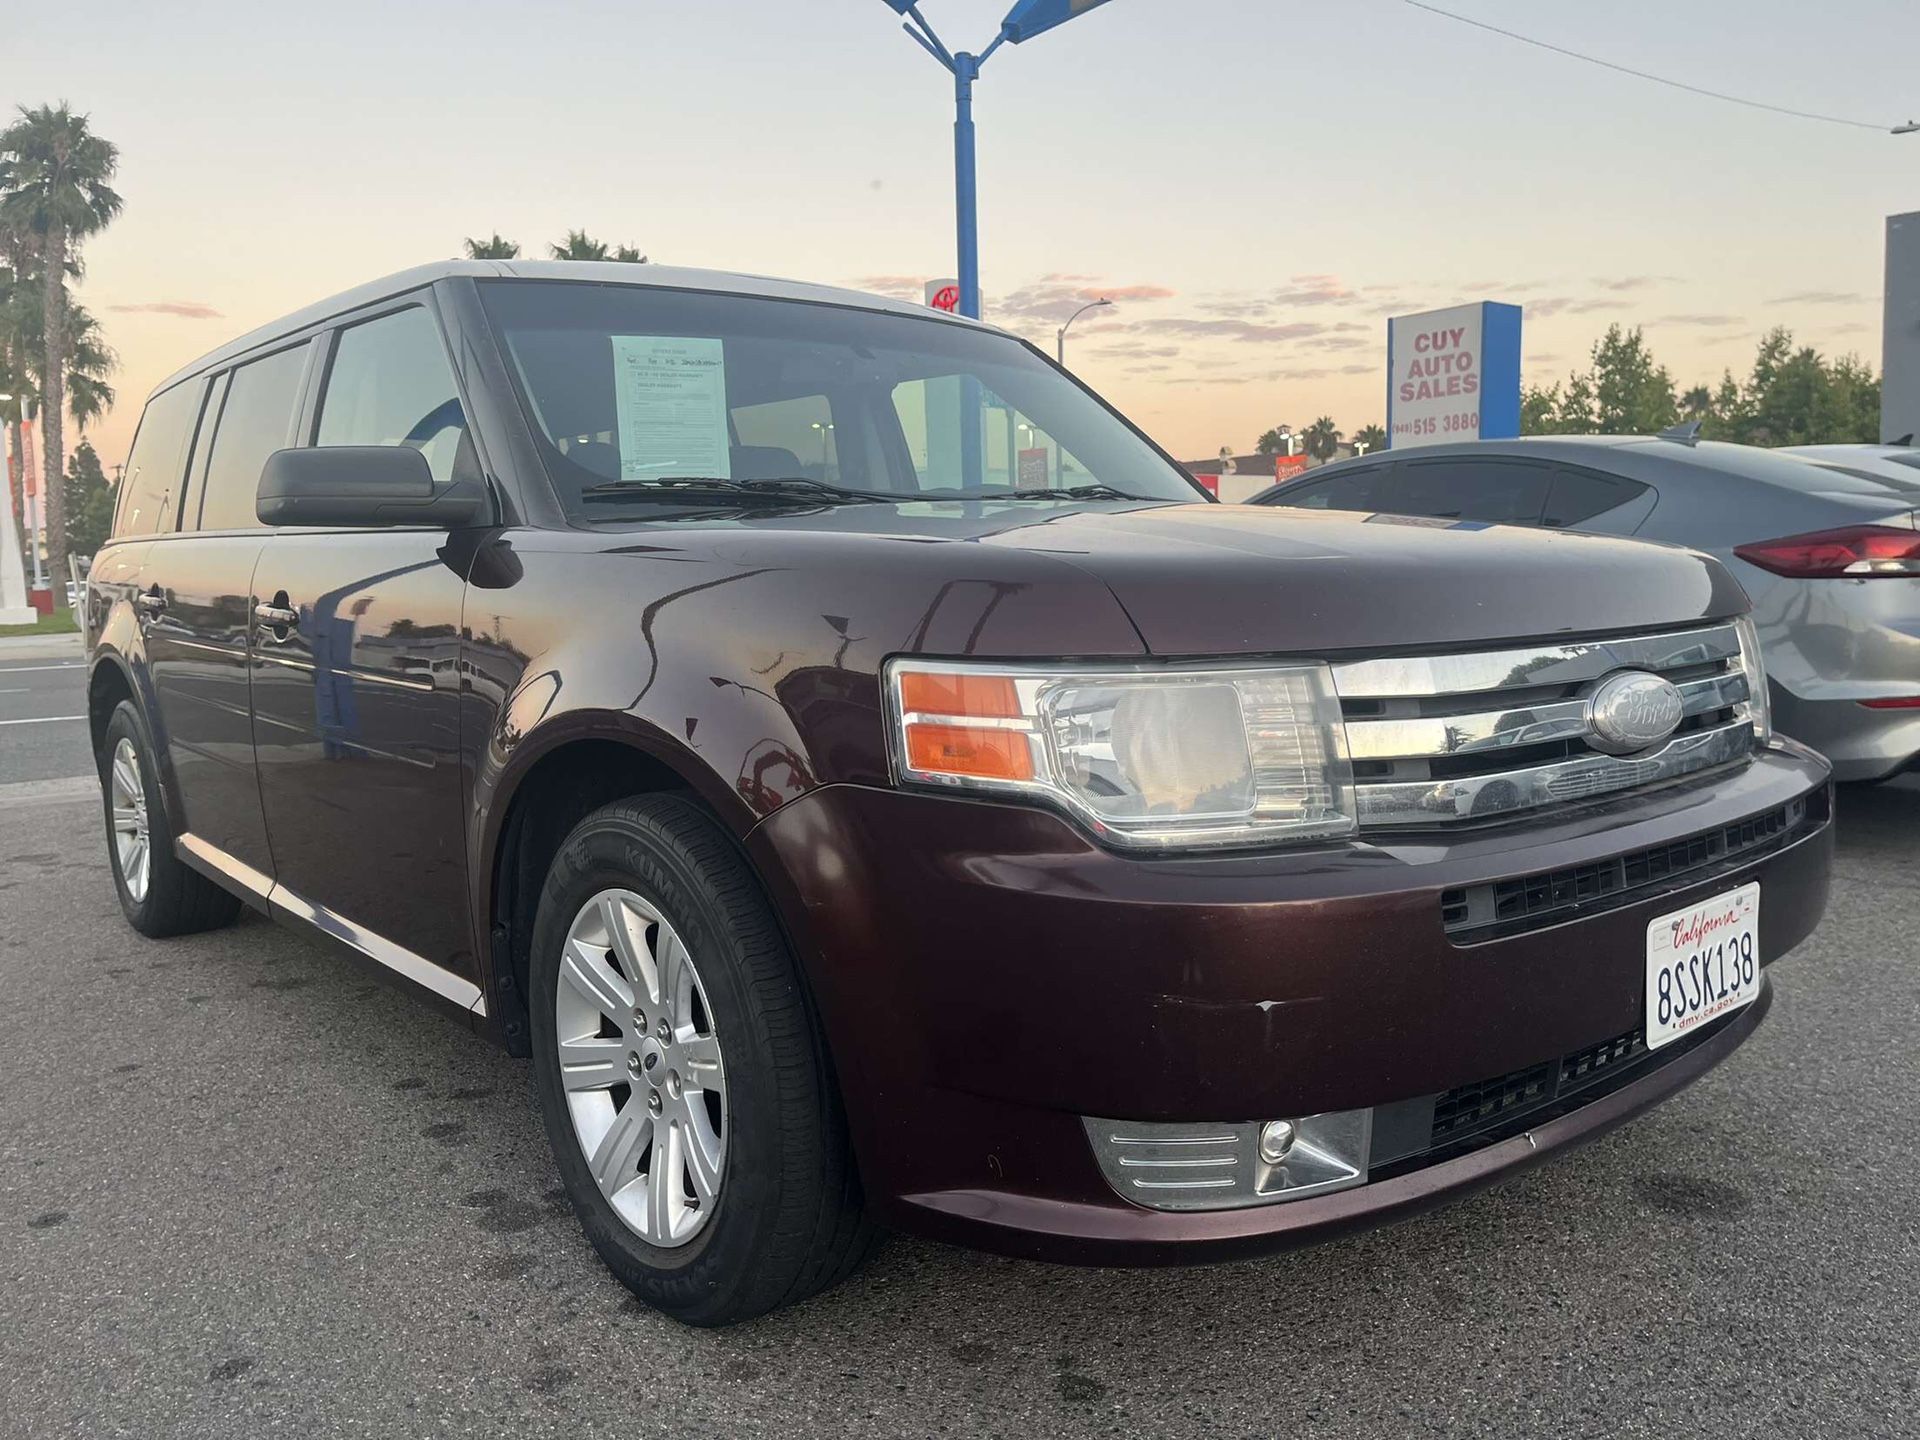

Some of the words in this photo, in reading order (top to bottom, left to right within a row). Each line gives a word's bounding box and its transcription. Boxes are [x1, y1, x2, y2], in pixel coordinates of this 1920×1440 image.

[1414, 327, 1465, 353] CUY
[1408, 351, 1473, 379] AUTO
[1400, 373, 1478, 402] SALES
[1443, 412, 1478, 432] 3880
[1673, 909, 1741, 949] California
[1658, 931, 1754, 1026] 8SSK138
[1678, 995, 1736, 1030] dmv.ca.gov
